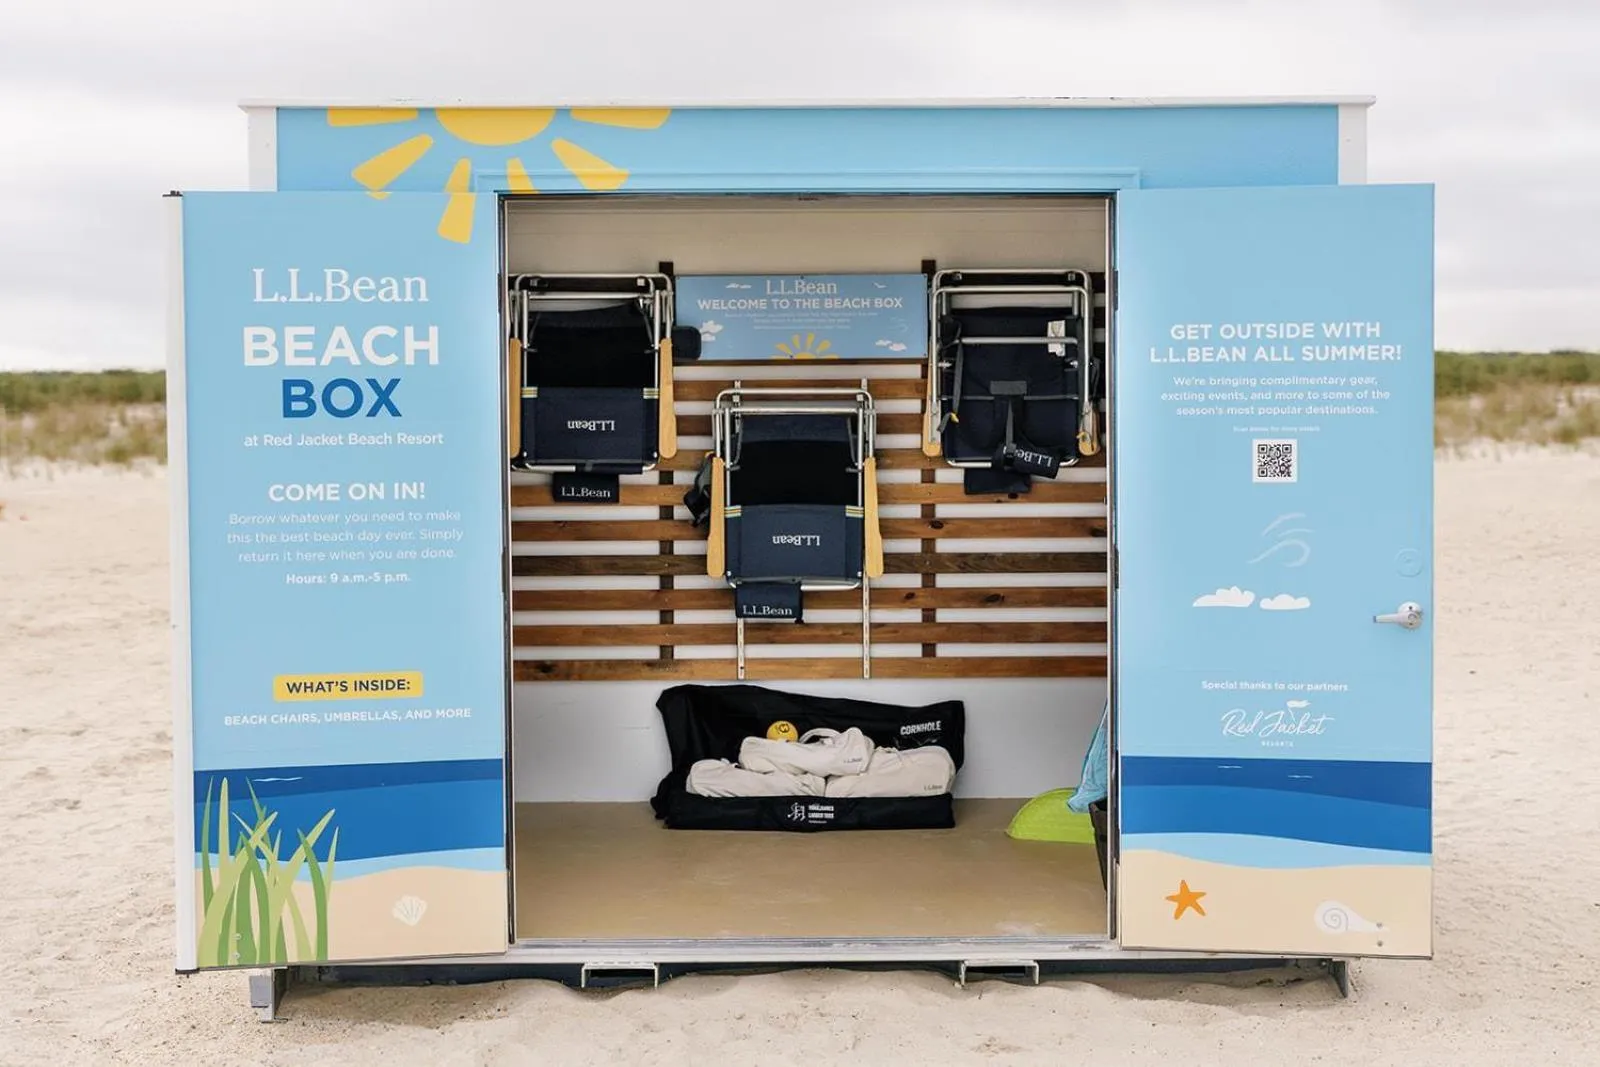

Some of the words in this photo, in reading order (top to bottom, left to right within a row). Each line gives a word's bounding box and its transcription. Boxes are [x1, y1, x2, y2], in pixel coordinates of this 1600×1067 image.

[252, 267, 429, 303] L.L.Bean
[765, 279, 837, 295] L.L.Bean
[698, 299, 767, 310] WELCOME
[772, 299, 790, 310] TO
[793, 298, 820, 309] THE
[824, 298, 870, 309] BEACH
[875, 297, 903, 309] BOX
[1170, 324, 1212, 341] GET
[1219, 323, 1315, 340] OUTSIDE
[1321, 322, 1381, 338] WITH
[243, 325, 439, 367] BEACH
[1150, 346, 1247, 364] L.L.BEAN
[1254, 346, 1294, 362] ALL
[1302, 345, 1402, 362] SUMMER!
[1173, 376, 1206, 386] We're
[1209, 375, 1257, 388] bringing
[1260, 375, 1346, 388] complimentary
[1349, 377, 1378, 387] gear,
[281, 377, 402, 419] BOX
[1161, 391, 1205, 402] exciting
[1208, 391, 1248, 402] events,
[1250, 390, 1272, 400] and
[1275, 392, 1305, 400] more
[1307, 391, 1319, 400] to
[1321, 391, 1353, 400] some
[1356, 390, 1369, 399] of
[1372, 389, 1390, 399] the
[1176, 406, 1224, 416] season's
[1227, 406, 1255, 415] most
[1258, 406, 1302, 417] popular
[1305, 405, 1378, 415] destinations.
[567, 420, 615, 431] L.L.Bean
[243, 434, 259, 446] at
[264, 434, 292, 446] Red
[297, 433, 343, 446] Jacket
[348, 433, 392, 445] Beach
[397, 432, 443, 445] Resort
[268, 483, 340, 502] COME
[348, 482, 385, 500] ON
[394, 482, 426, 500] IN!
[561, 486, 611, 498] L.L.Bean
[228, 513, 276, 525] Borrow
[279, 513, 339, 524] whatever
[344, 514, 368, 526] you
[372, 511, 404, 522] need
[408, 511, 422, 522] to
[426, 510, 461, 521] make
[227, 533, 251, 544] this
[255, 532, 275, 543] the
[281, 532, 309, 543] best
[313, 531, 353, 542] beach
[357, 530, 381, 545] day
[385, 532, 415, 541] ever.
[419, 529, 463, 543] Simply
[772, 534, 821, 546] L.L.Bean
[238, 551, 279, 562] return
[283, 550, 292, 561] it
[296, 549, 325, 561] here
[329, 549, 365, 560] when
[369, 550, 393, 562] you
[396, 550, 417, 559] are
[421, 548, 456, 559] done.
[286, 573, 327, 585] Hours:
[330, 573, 338, 584] 9
[384, 573, 411, 585] p.m.
[742, 605, 793, 616] L.L.Bean
[286, 680, 348, 694] WHAT'S
[353, 678, 411, 692] INSIDE:
[1201, 681, 1237, 691] Special
[1239, 681, 1272, 690] thanks
[1274, 681, 1285, 690] to
[1287, 682, 1304, 691] our
[1306, 682, 1348, 692] partners
[224, 714, 267, 726] BEACH
[271, 713, 321, 724] CHAIRS,
[324, 710, 402, 723] UMBRELLAS,
[405, 709, 432, 720] AND
[435, 708, 472, 719] MORE
[1221, 708, 1263, 737] Red
[1259, 706, 1335, 737] Jacket
[900, 720, 942, 736] CORNHOLE
